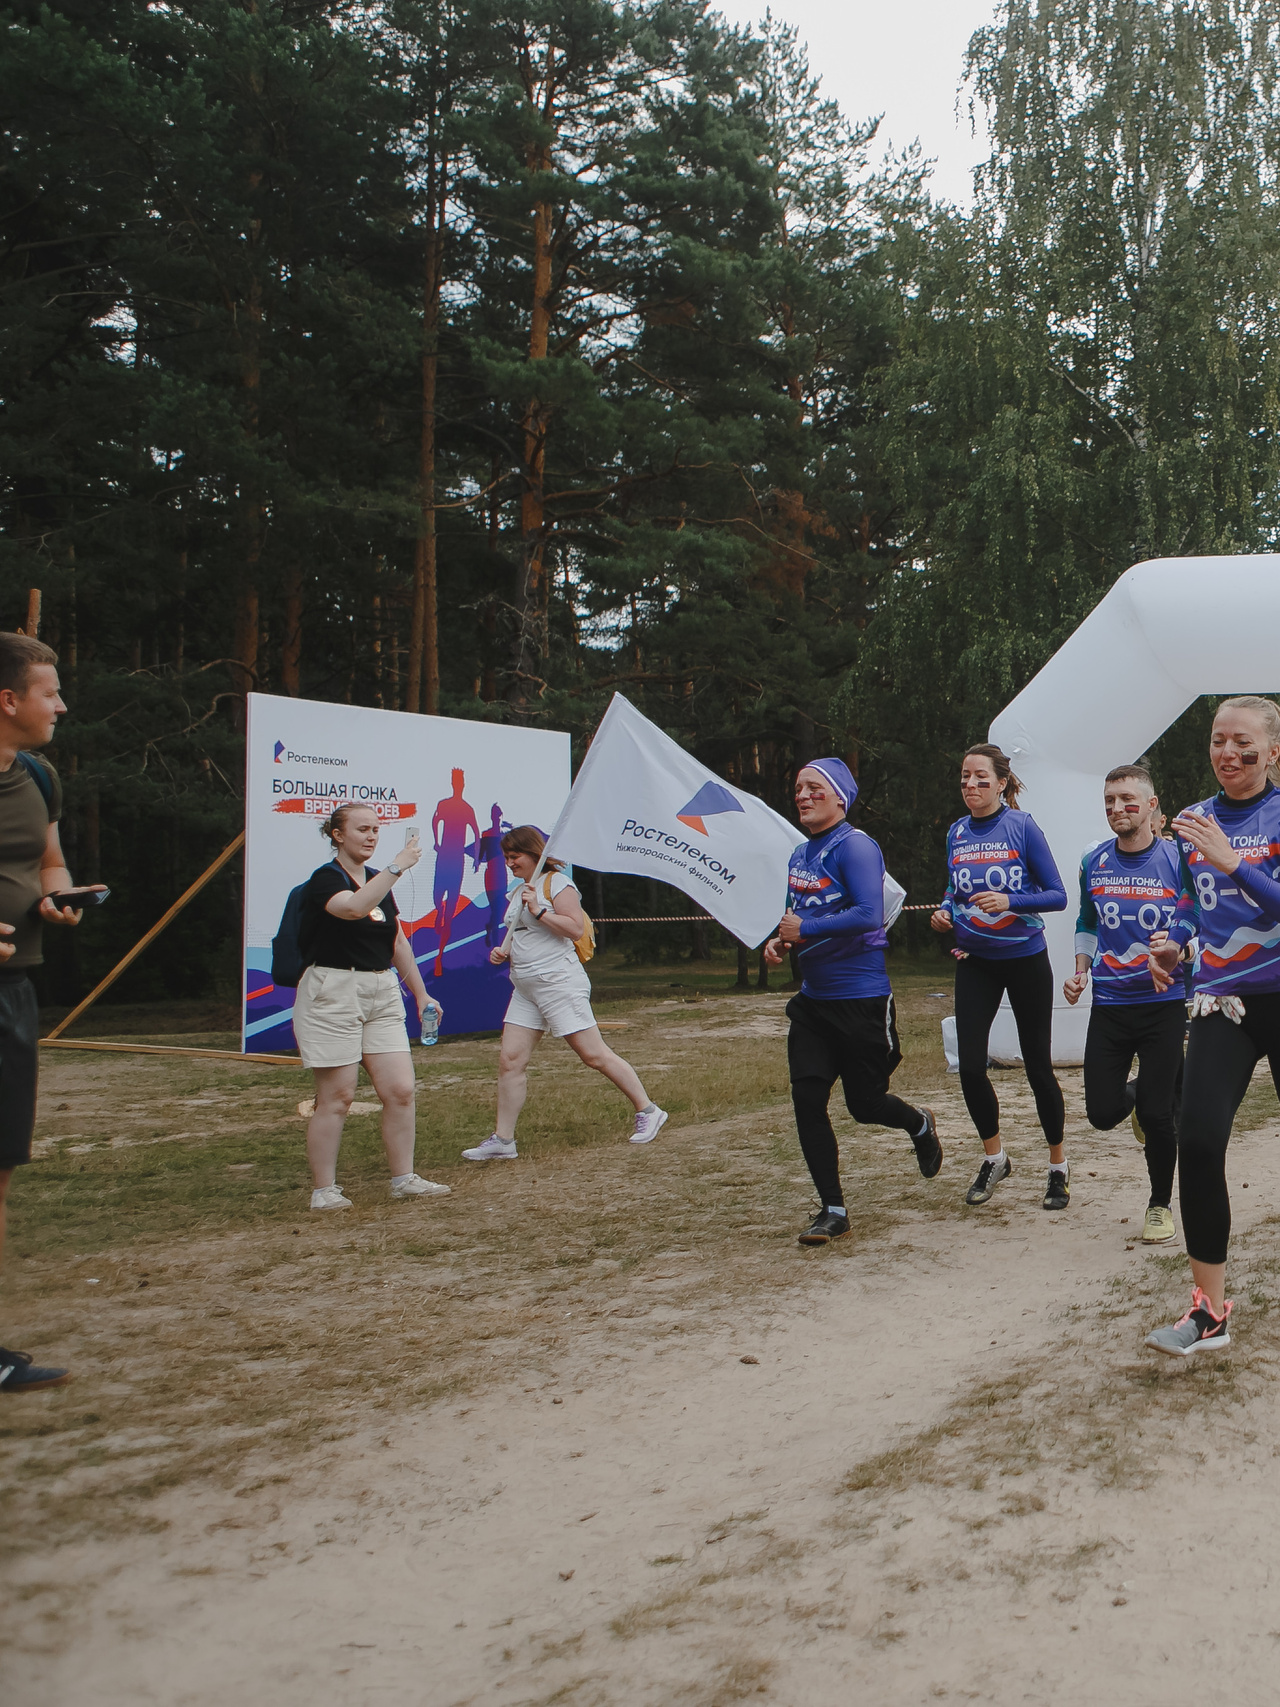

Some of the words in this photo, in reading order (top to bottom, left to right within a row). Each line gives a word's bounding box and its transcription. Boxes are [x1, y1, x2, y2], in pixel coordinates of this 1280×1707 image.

[287, 751, 348, 766] Ростелеком
[272, 779, 347, 798] БОЛЬШАЯ
[352, 785, 398, 801] ГОНКА
[304, 800, 349, 815] ВРЕМ
[621, 819, 737, 885] Ростелеком
[953, 843, 980, 857] БОЛЬШАЯ
[981, 842, 1008, 852] ГОНКА
[960, 852, 980, 861] ВРЕМЯ
[981, 851, 1009, 860] ГЕРОЕВ
[616, 842, 688, 869] Нижегородский
[688, 866, 724, 896] филиал
[1090, 876, 1130, 887] БОЛЬШАЯ
[1131, 877, 1163, 888] ГОНКА
[1104, 886, 1130, 894] ВРЕМЯ
[1131, 887, 1164, 897] ГЕРОЕВ
